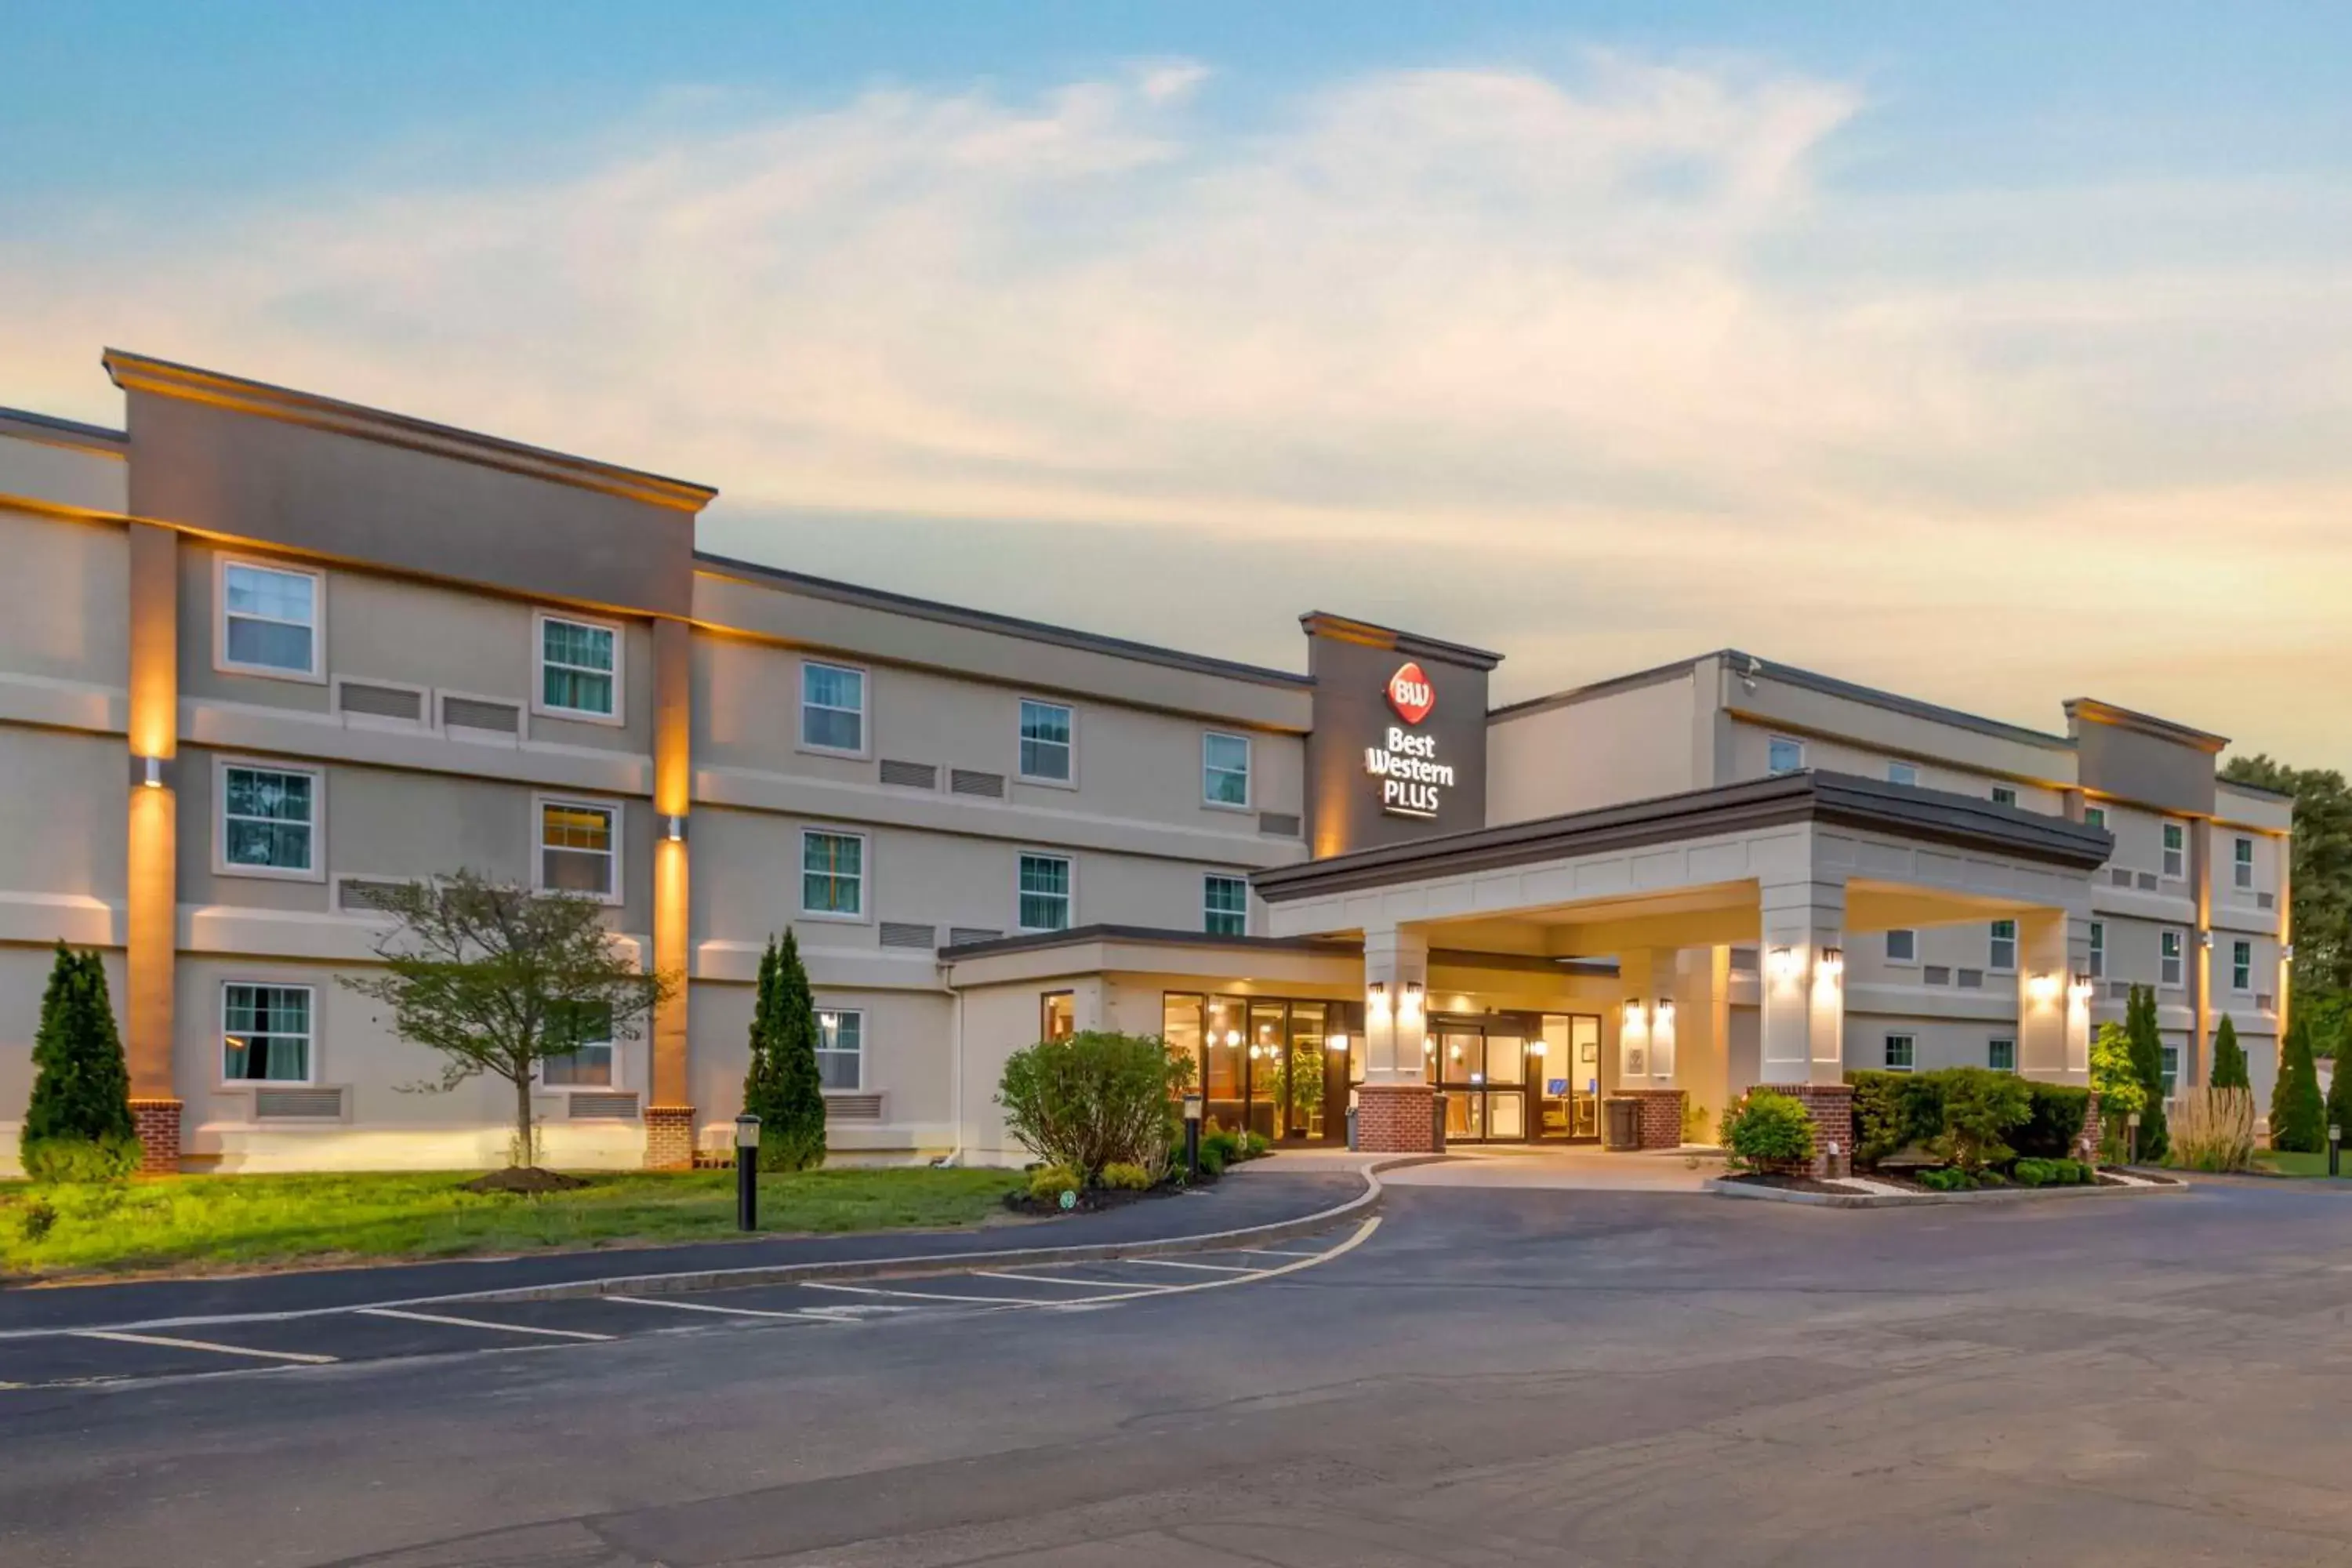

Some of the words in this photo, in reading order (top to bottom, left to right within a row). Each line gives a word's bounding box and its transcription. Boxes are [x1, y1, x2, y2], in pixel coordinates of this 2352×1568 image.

[1396, 681, 1428, 706] BW
[1388, 728, 1435, 758] Best
[1366, 748, 1454, 786] Western
[1385, 779, 1439, 810] PLUS
